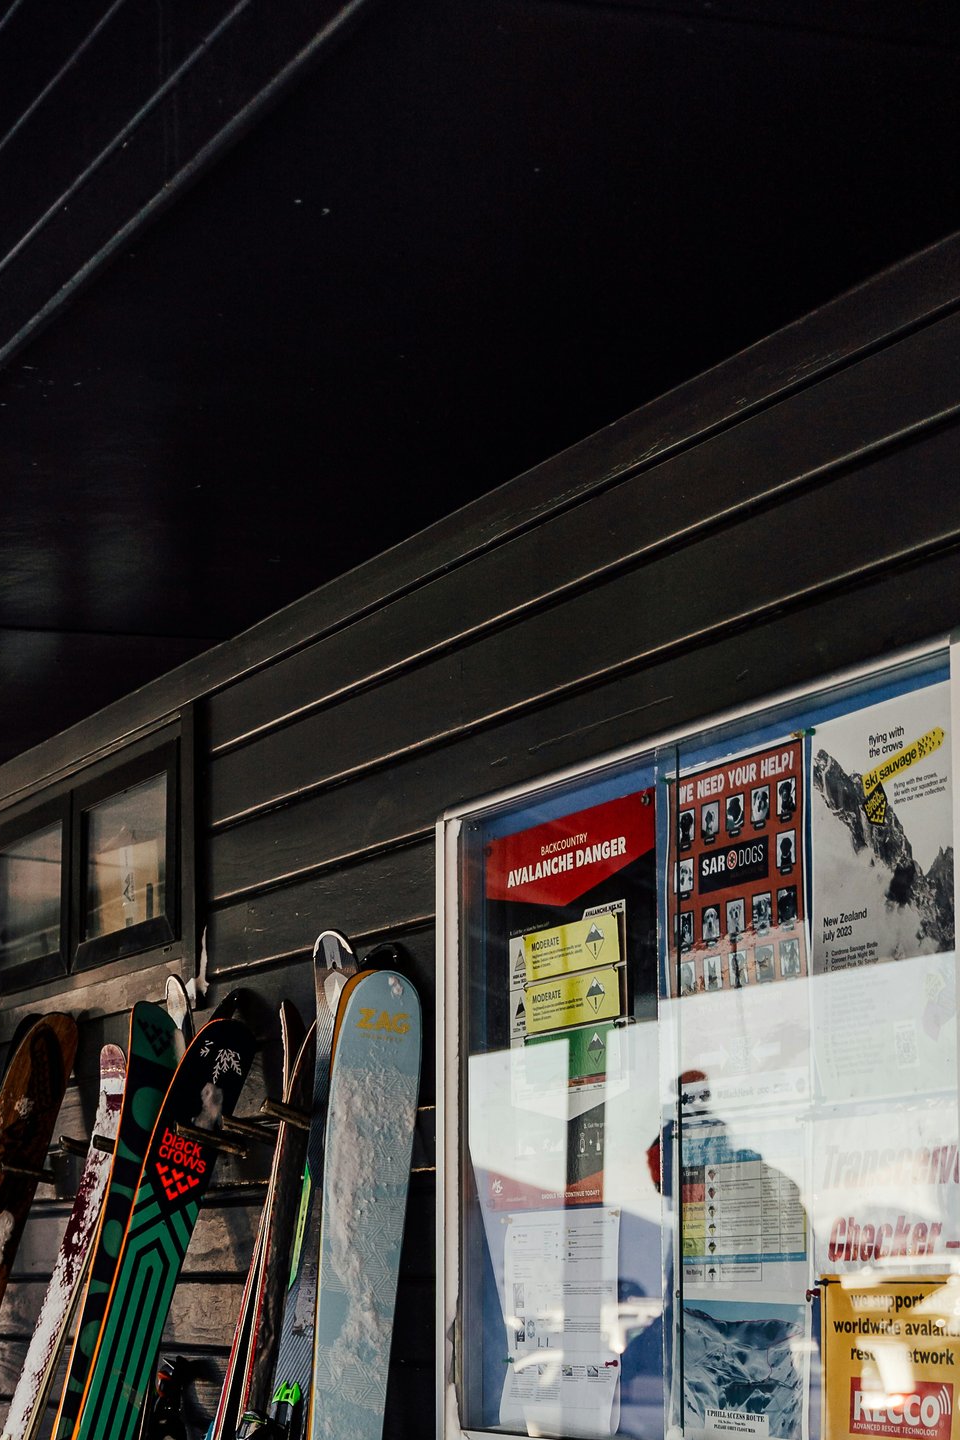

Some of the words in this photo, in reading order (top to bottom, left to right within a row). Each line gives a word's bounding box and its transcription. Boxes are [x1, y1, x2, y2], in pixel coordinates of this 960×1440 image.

[869, 732, 887, 748] flying
[889, 725, 905, 739] with
[869, 747, 881, 758] the
[882, 740, 903, 754] crows
[679, 783, 694, 805] WE
[697, 773, 725, 799] NEED
[728, 762, 757, 789] YOUR
[760, 750, 794, 779] HELP!
[865, 771, 879, 790] ski
[879, 748, 918, 780] sauvage
[541, 832, 588, 856] BACKCOUNTRY
[507, 851, 574, 889] AVALANCHE
[575, 836, 627, 868] DANGER
[702, 854, 726, 876] SAR
[738, 844, 765, 867] DOGS
[823, 917, 839, 928] New
[840, 908, 868, 924] Zealand
[531, 936, 560, 952] MODERATE
[822, 930, 836, 944] july
[836, 925, 853, 939] 2023
[532, 989, 562, 1005] MODERATE
[355, 1007, 411, 1035] ZAG
[161, 1127, 203, 1159] black
[158, 1145, 207, 1174] crows
[827, 1215, 943, 1262] Checker
[850, 1294, 869, 1309] we
[869, 1293, 925, 1313] support
[833, 1317, 901, 1336] worldwide
[706, 1409, 727, 1419] UPHILL
[727, 1412, 746, 1421] ACCESS
[746, 1414, 765, 1423] ROUTE
[853, 1422, 880, 1432] ADVANCED
[881, 1425, 901, 1434] RESCUE
[902, 1427, 938, 1437] TECHNOLOGY
